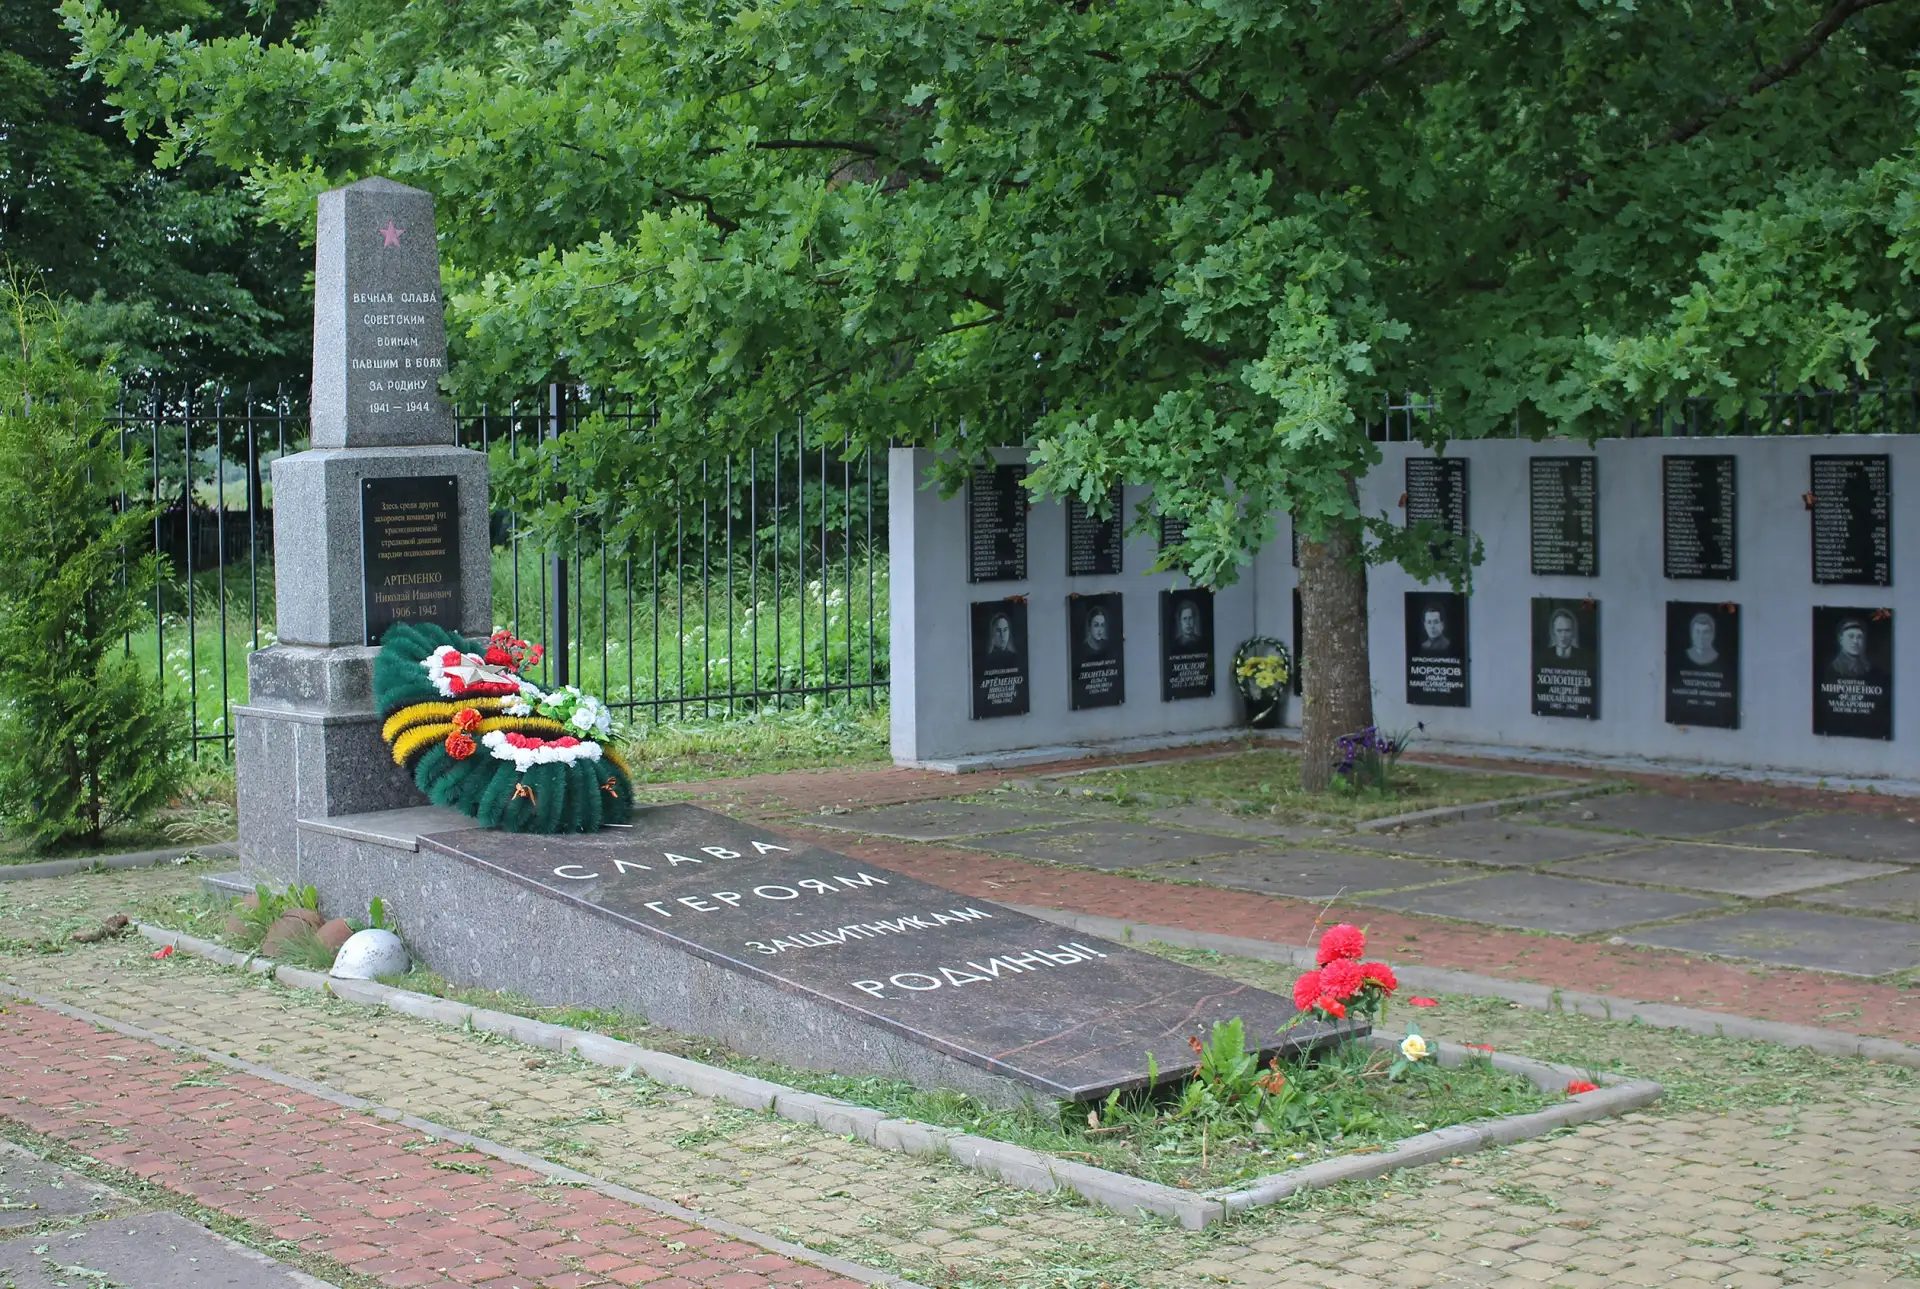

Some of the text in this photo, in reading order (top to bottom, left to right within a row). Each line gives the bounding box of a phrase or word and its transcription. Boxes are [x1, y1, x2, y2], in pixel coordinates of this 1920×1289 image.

[353, 292, 437, 303] ВЕЧНАЯ СЛАВА
[364, 314, 425, 324] СОВЕТСКИМ
[377, 336, 418, 346] ВОИНАМ
[352, 357, 442, 369] ПАВШИМ В БОЯХ
[369, 379, 428, 391] ЗА РОДИНУ
[370, 402, 389, 413] 1941
[406, 402, 429, 412] 1944
[418, 501, 440, 511] других
[436, 511, 447, 519] 191
[384, 572, 442, 586] АРТЕМЕНКО
[375, 589, 452, 603] Николай Иванович
[392, 607, 411, 618] 1906
[418, 605, 437, 616] 1942
[1411, 666, 1462, 676] МОРОЗОВ
[1537, 674, 1592, 687] ХОЛОПЦЕВ
[1821, 684, 1883, 696] МИРОНЕНКО
[553, 840, 790, 880] СЛАВА
[644, 871, 889, 918] ГЕРОЯМ
[744, 906, 993, 956] ЗАЩИТНИКАМ
[850, 942, 1108, 999] РОДИНЫ!
